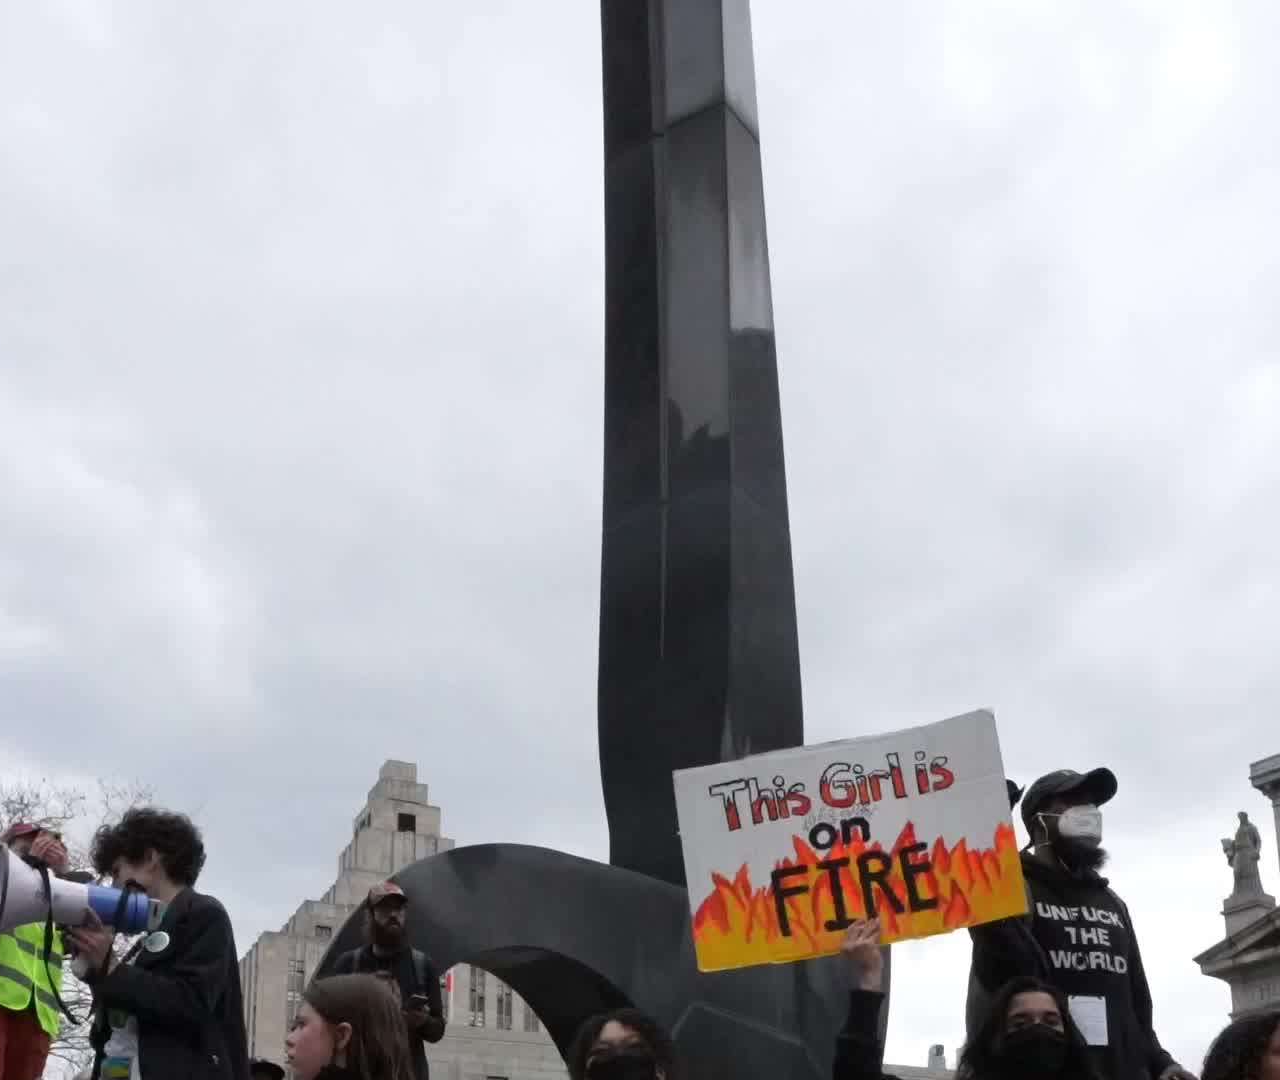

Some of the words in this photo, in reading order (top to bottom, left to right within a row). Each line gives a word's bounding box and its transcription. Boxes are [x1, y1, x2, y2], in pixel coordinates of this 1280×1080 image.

[708, 775, 812, 832] This
[819, 752, 908, 808] Girl
[914, 750, 955, 795] is
[808, 816, 872, 850] on
[771, 842, 939, 937] FIRE
[1036, 901, 1125, 929] UNFUCK
[1064, 926, 1112, 946] THE
[1048, 950, 1128, 974] WORLD
